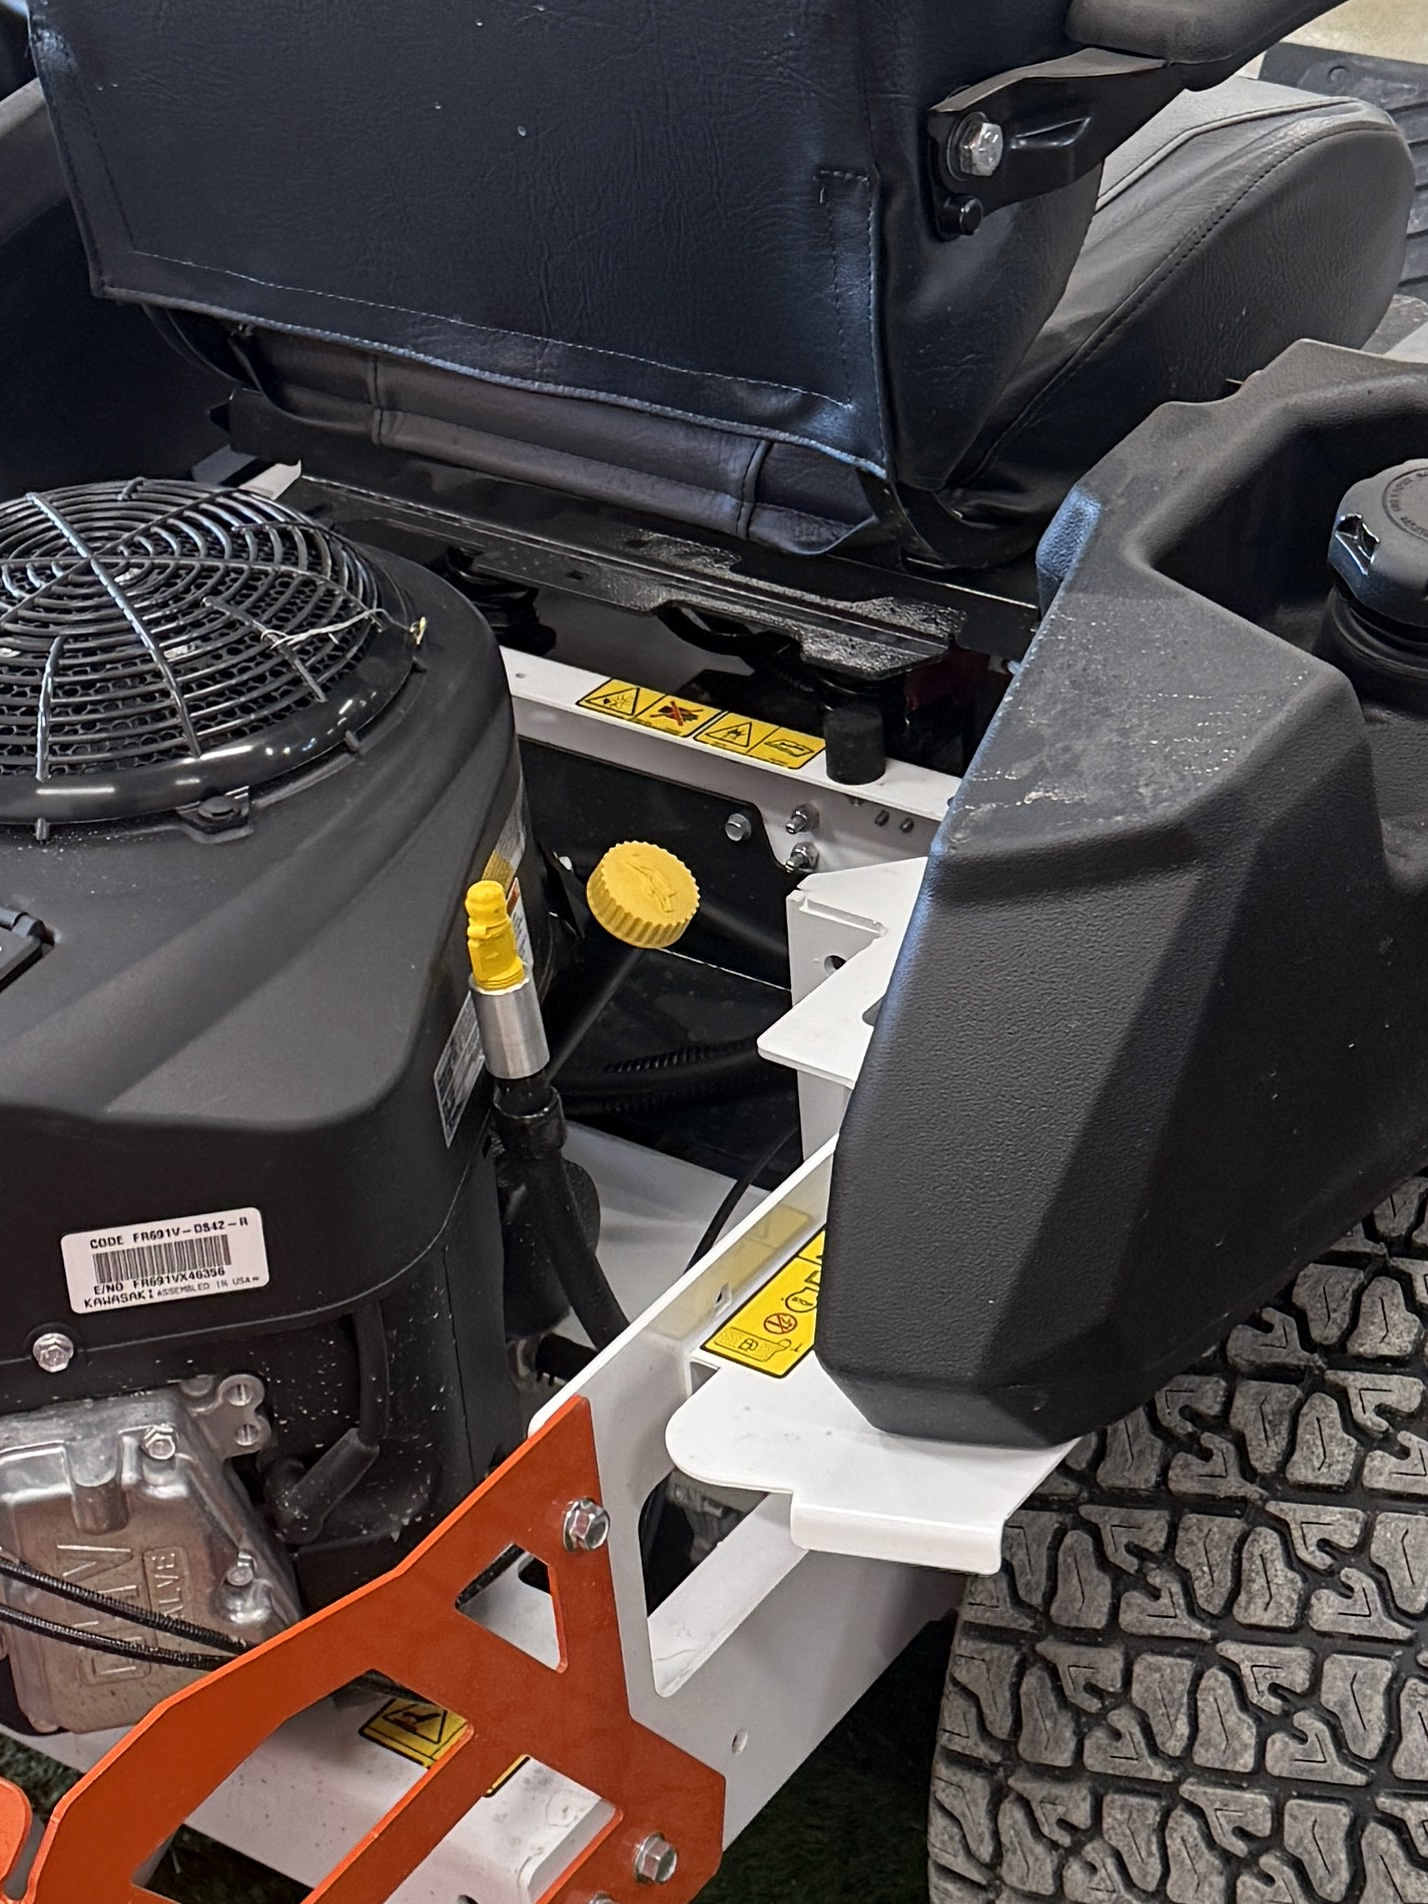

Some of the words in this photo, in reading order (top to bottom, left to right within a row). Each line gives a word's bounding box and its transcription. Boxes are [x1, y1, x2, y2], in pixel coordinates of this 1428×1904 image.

[90, 1236, 124, 1249] CODE
[84, 1289, 154, 1308] KAWASAKI
[157, 1282, 210, 1297] ASSEMBLED
[94, 1283, 124, 1294] E/NO
